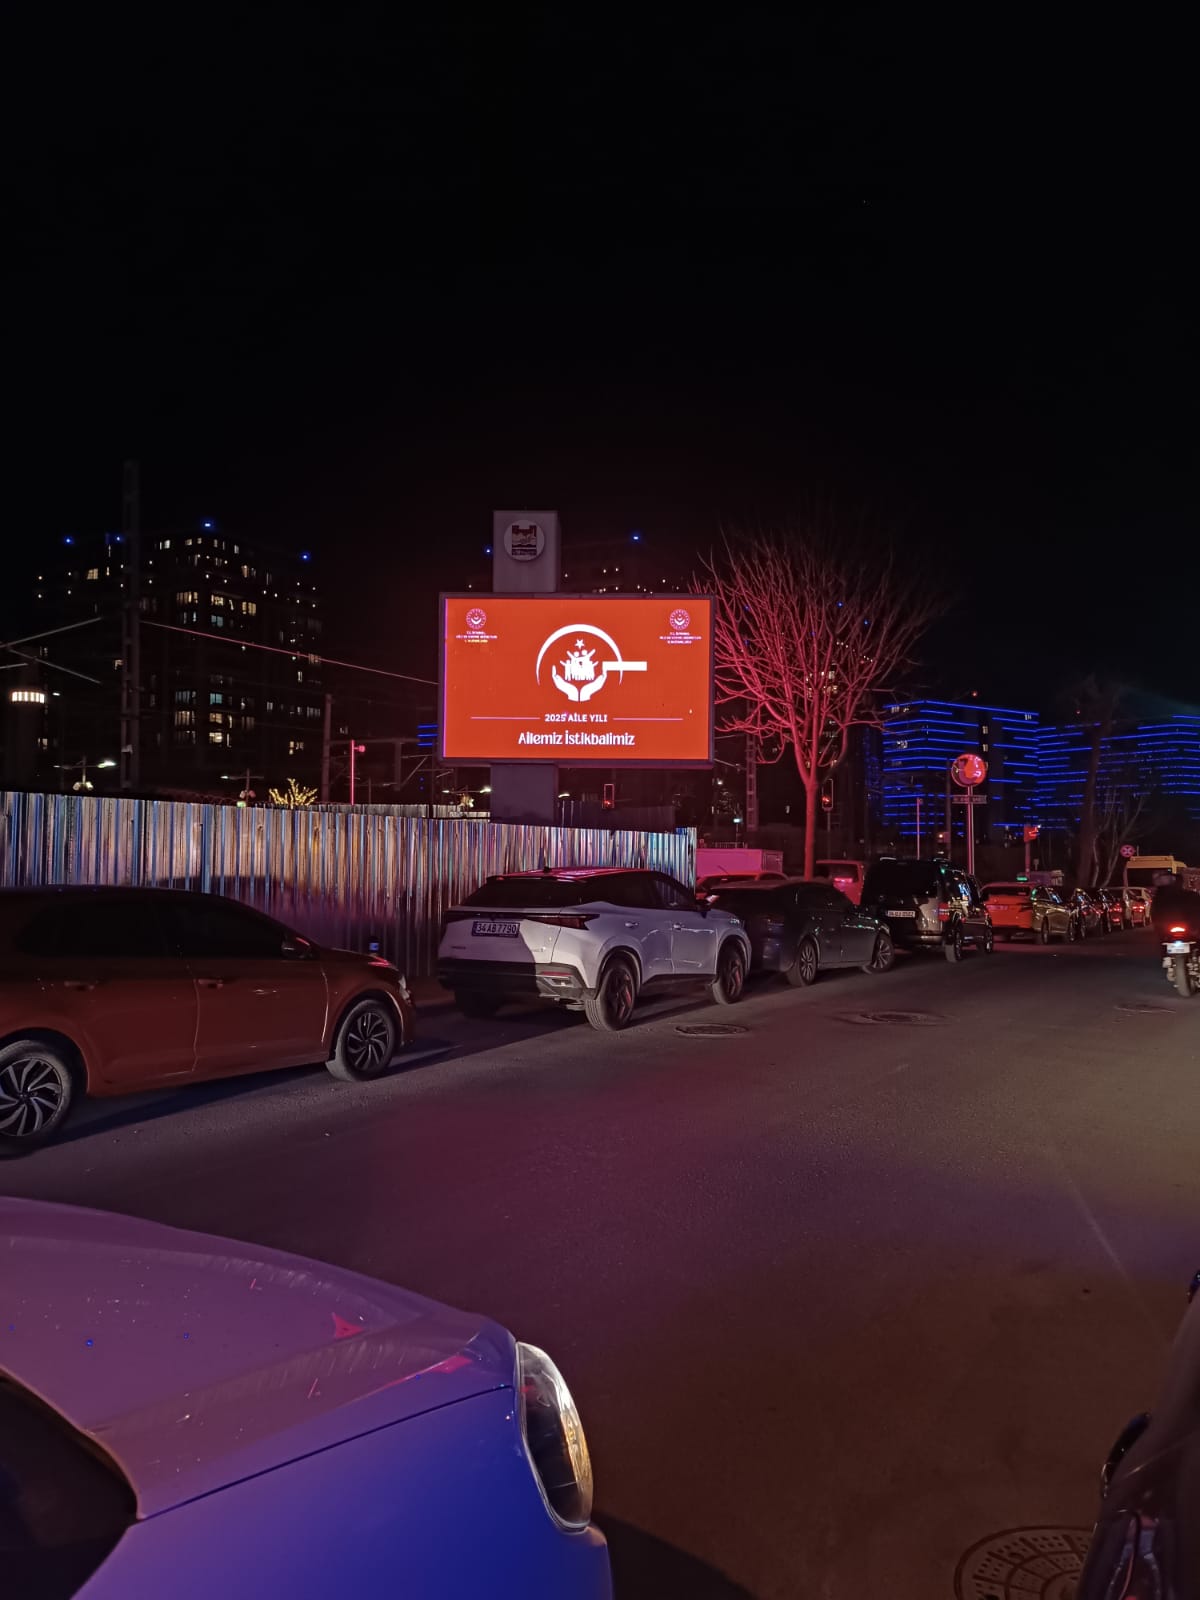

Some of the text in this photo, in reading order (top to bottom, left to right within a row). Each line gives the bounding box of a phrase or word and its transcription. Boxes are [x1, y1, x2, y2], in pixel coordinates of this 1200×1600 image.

[568, 712, 587, 722] AİLE
[589, 714, 608, 722] YILI
[518, 730, 635, 746] Ailemiz İstikbalimiz
